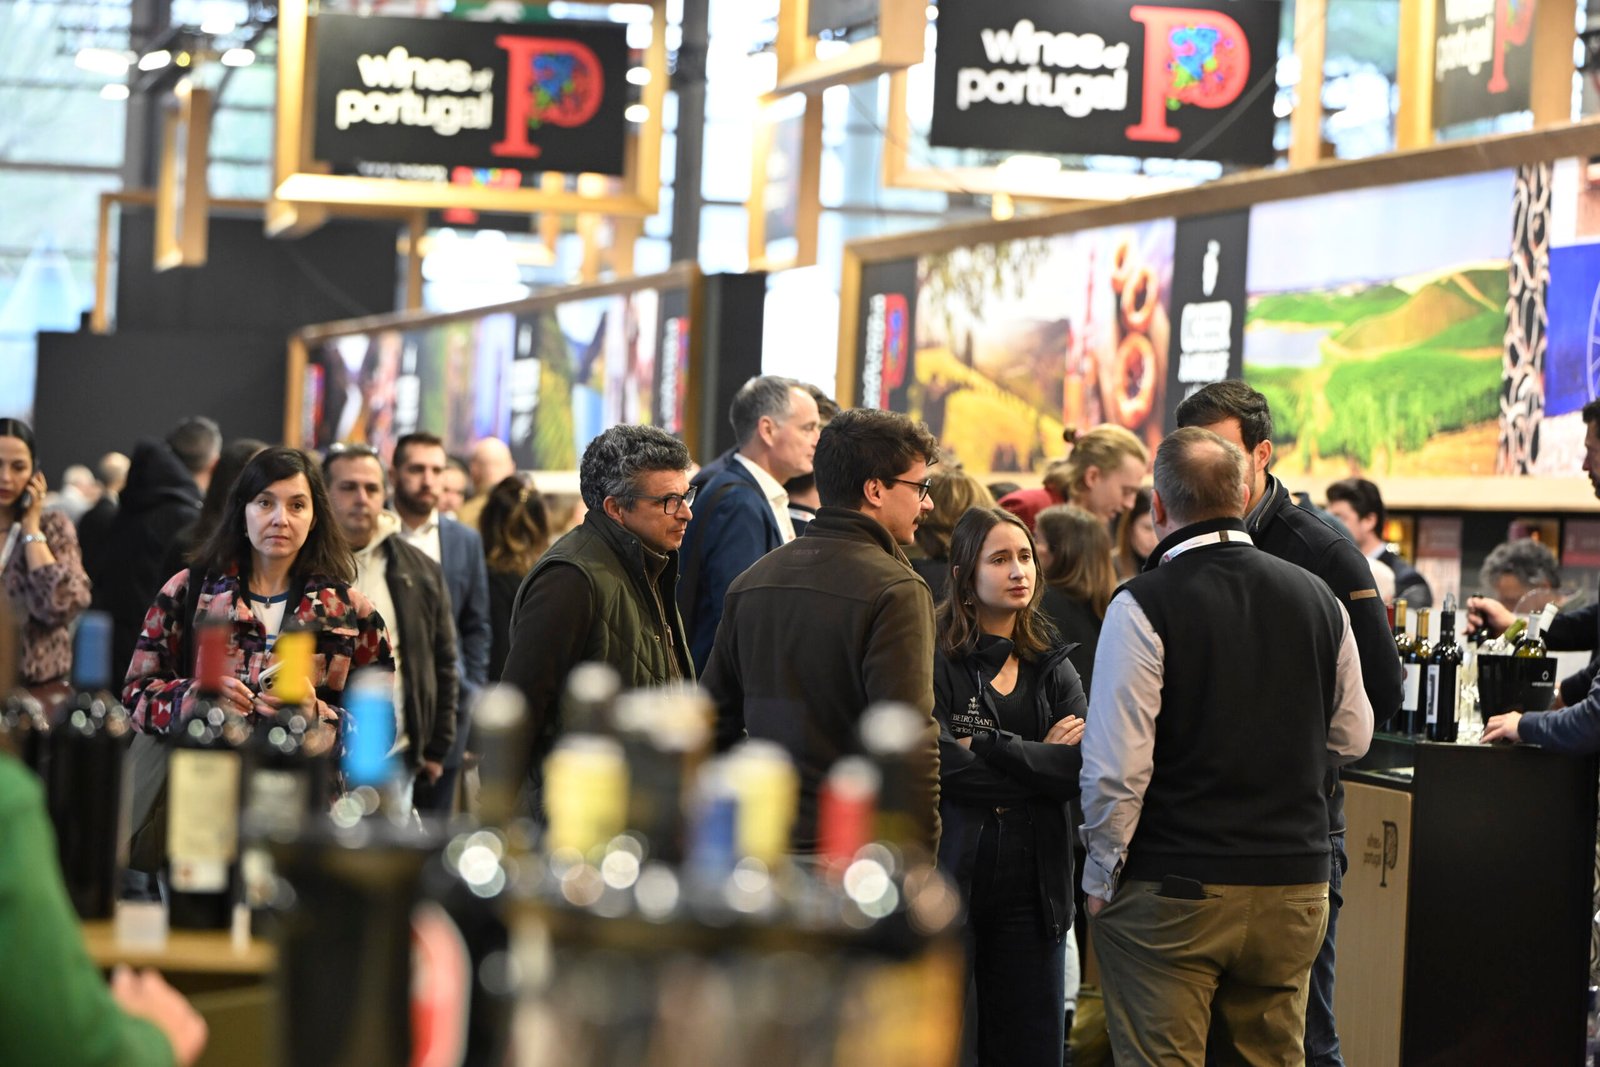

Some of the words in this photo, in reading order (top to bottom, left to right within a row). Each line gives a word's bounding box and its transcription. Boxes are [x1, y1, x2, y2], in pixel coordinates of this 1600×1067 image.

[335, 88, 494, 136] portugal
[956, 65, 1129, 118] portugal
[952, 713, 973, 723] BEIRO
[974, 716, 993, 727] SANT
